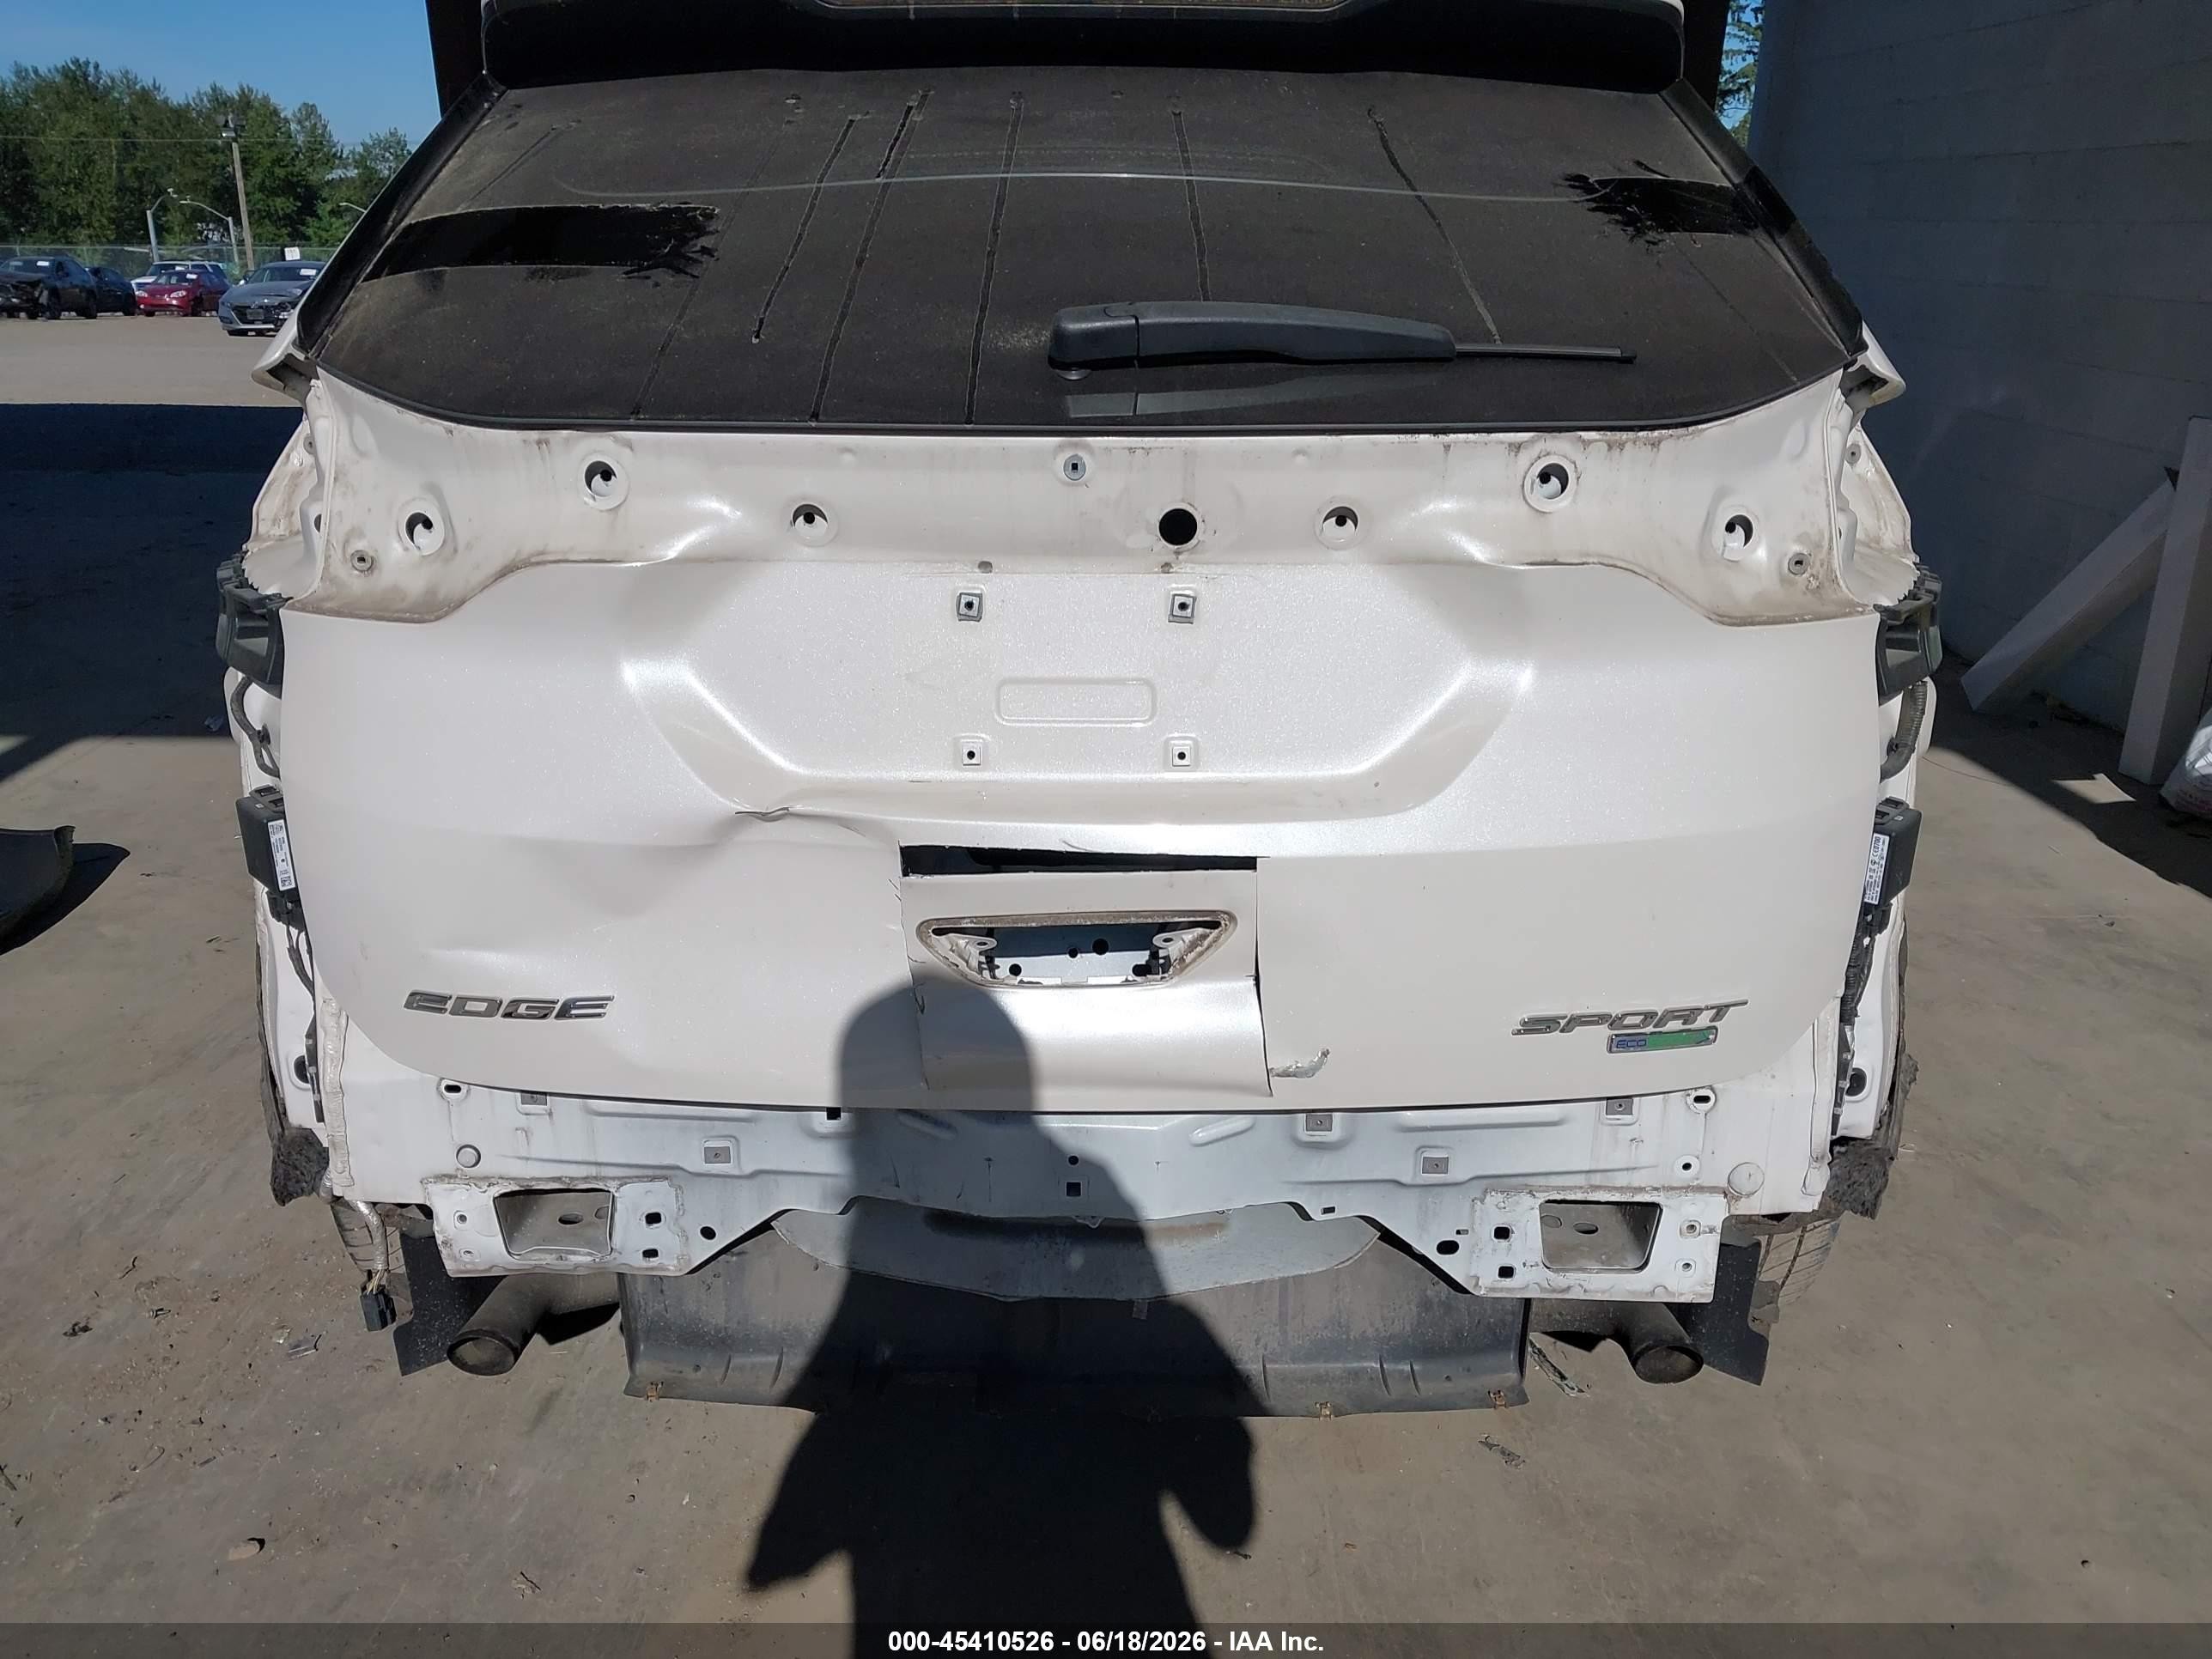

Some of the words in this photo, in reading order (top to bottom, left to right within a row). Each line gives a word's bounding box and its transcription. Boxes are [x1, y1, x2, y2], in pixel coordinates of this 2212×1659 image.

[403, 989, 615, 1020] EDGE
[1511, 999, 1748, 1036] SPORT
[1616, 1039, 1647, 1049] ECO
